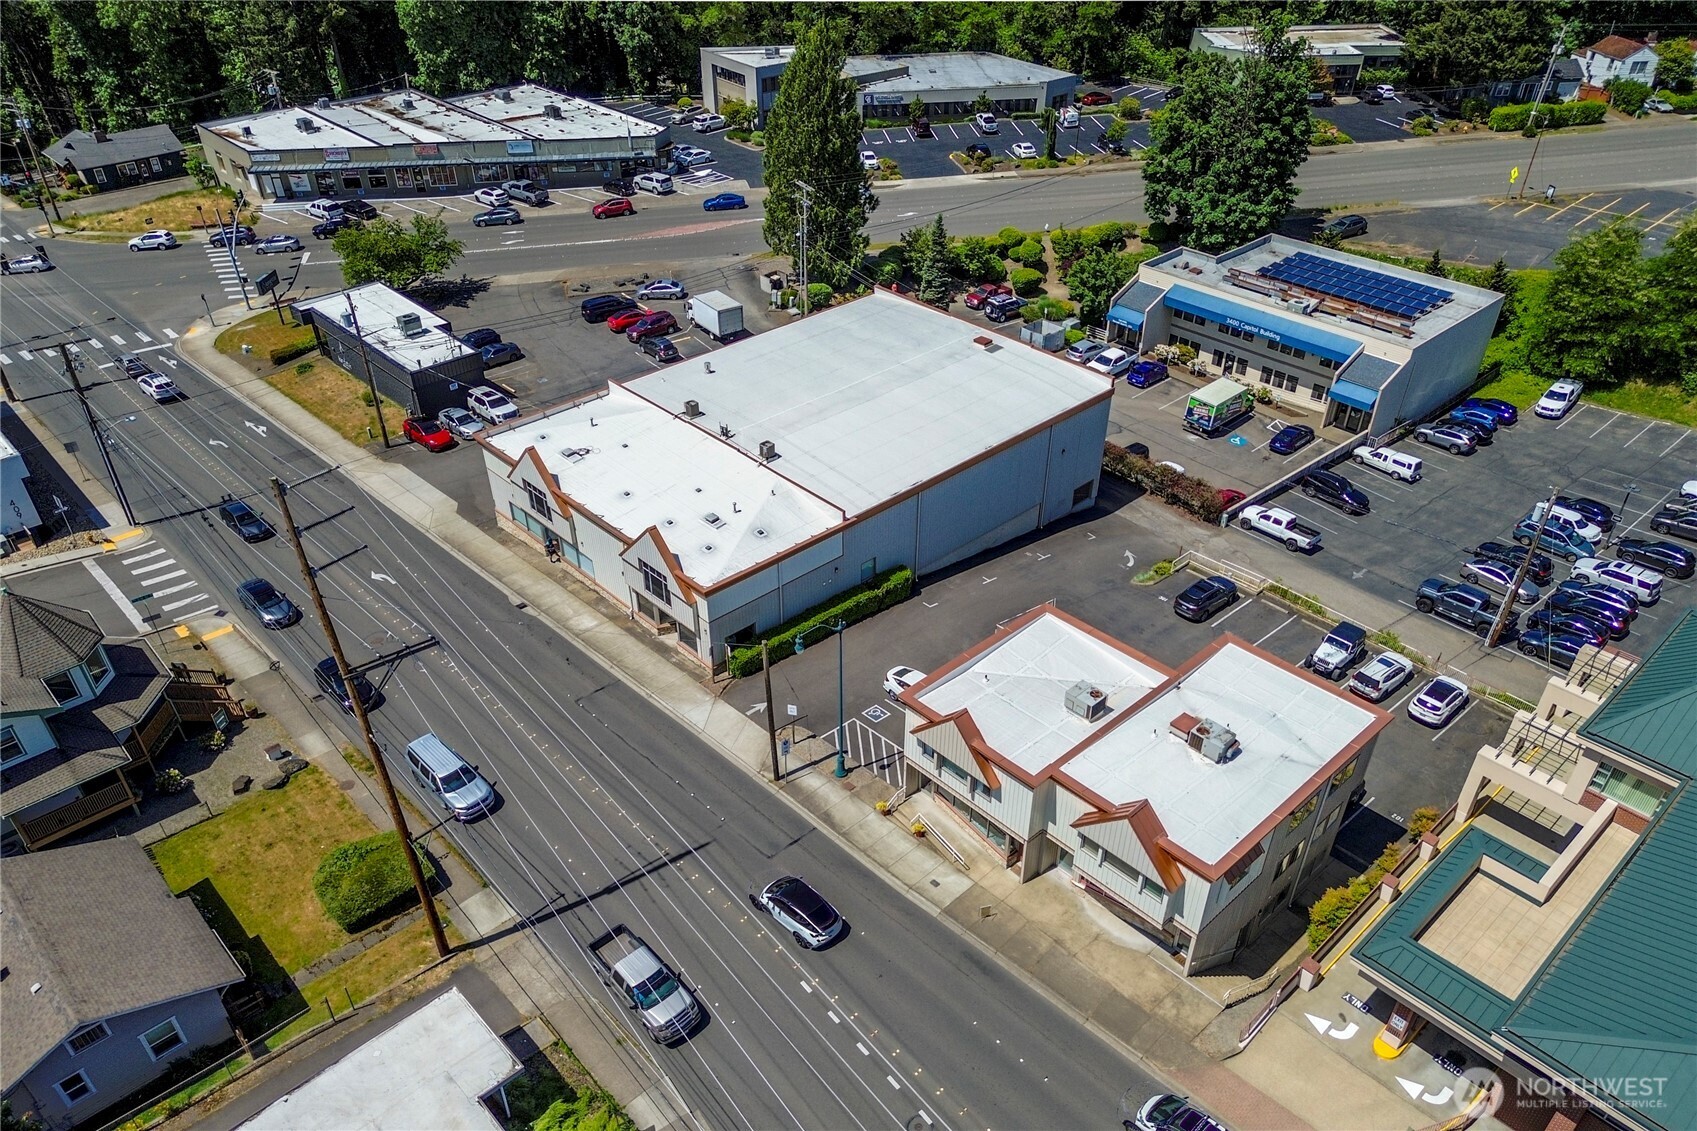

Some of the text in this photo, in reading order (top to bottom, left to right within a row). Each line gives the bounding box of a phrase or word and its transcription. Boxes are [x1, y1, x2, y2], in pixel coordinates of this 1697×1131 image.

[1226, 317, 1281, 341] 3400 Capitol Building
[10, 499, 22, 519] 409
[1342, 993, 1369, 1012] ONLY
[1391, 1020, 1404, 1030] ONLY
[1393, 1015, 1405, 1025] EXIT
[1434, 1056, 1463, 1077] ONLY
